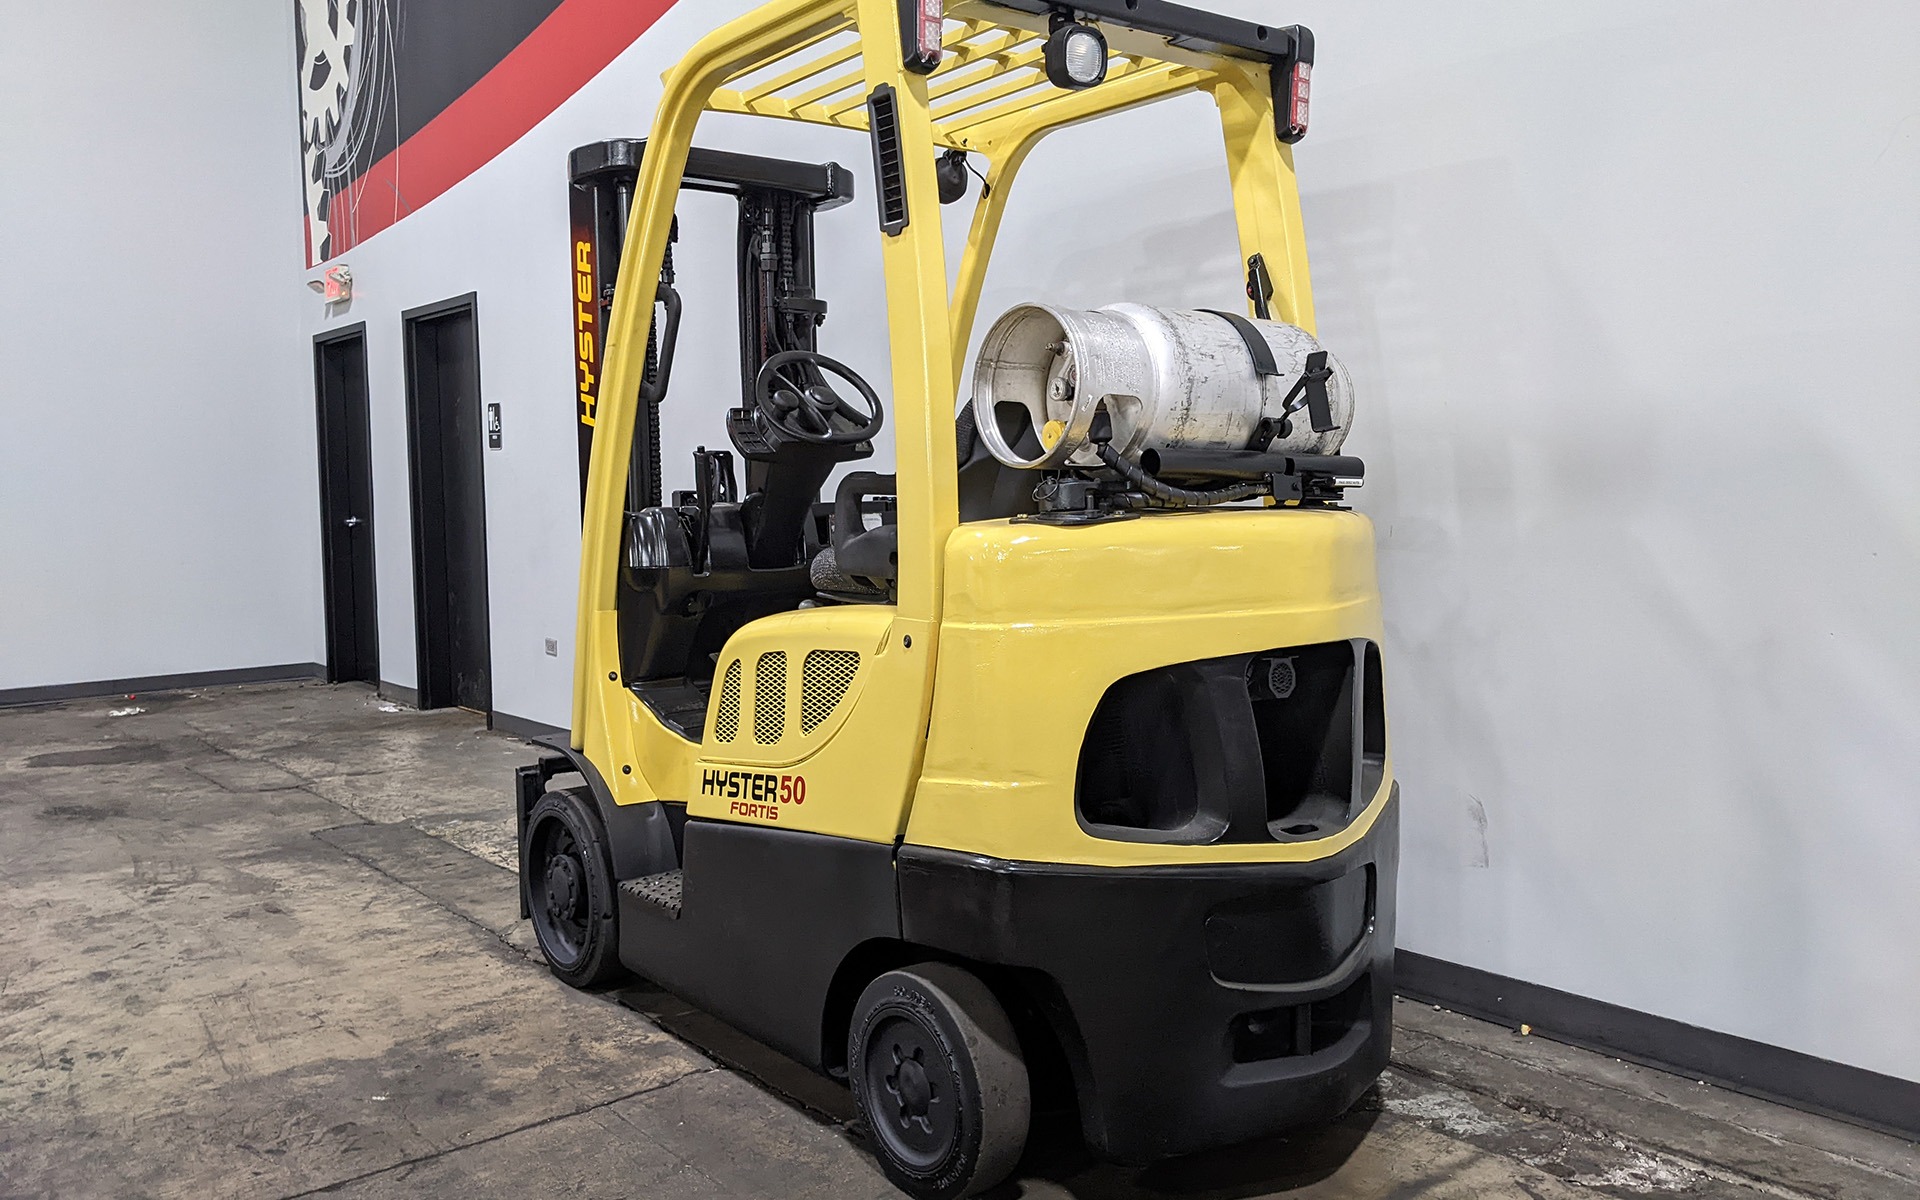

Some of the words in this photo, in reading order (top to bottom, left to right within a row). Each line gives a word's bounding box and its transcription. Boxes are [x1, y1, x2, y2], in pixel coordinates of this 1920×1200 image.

[576, 241, 597, 427] HYSTER
[701, 769, 778, 803] HYSTER
[779, 775, 806, 805] 50
[730, 801, 778, 820] FORTIS
